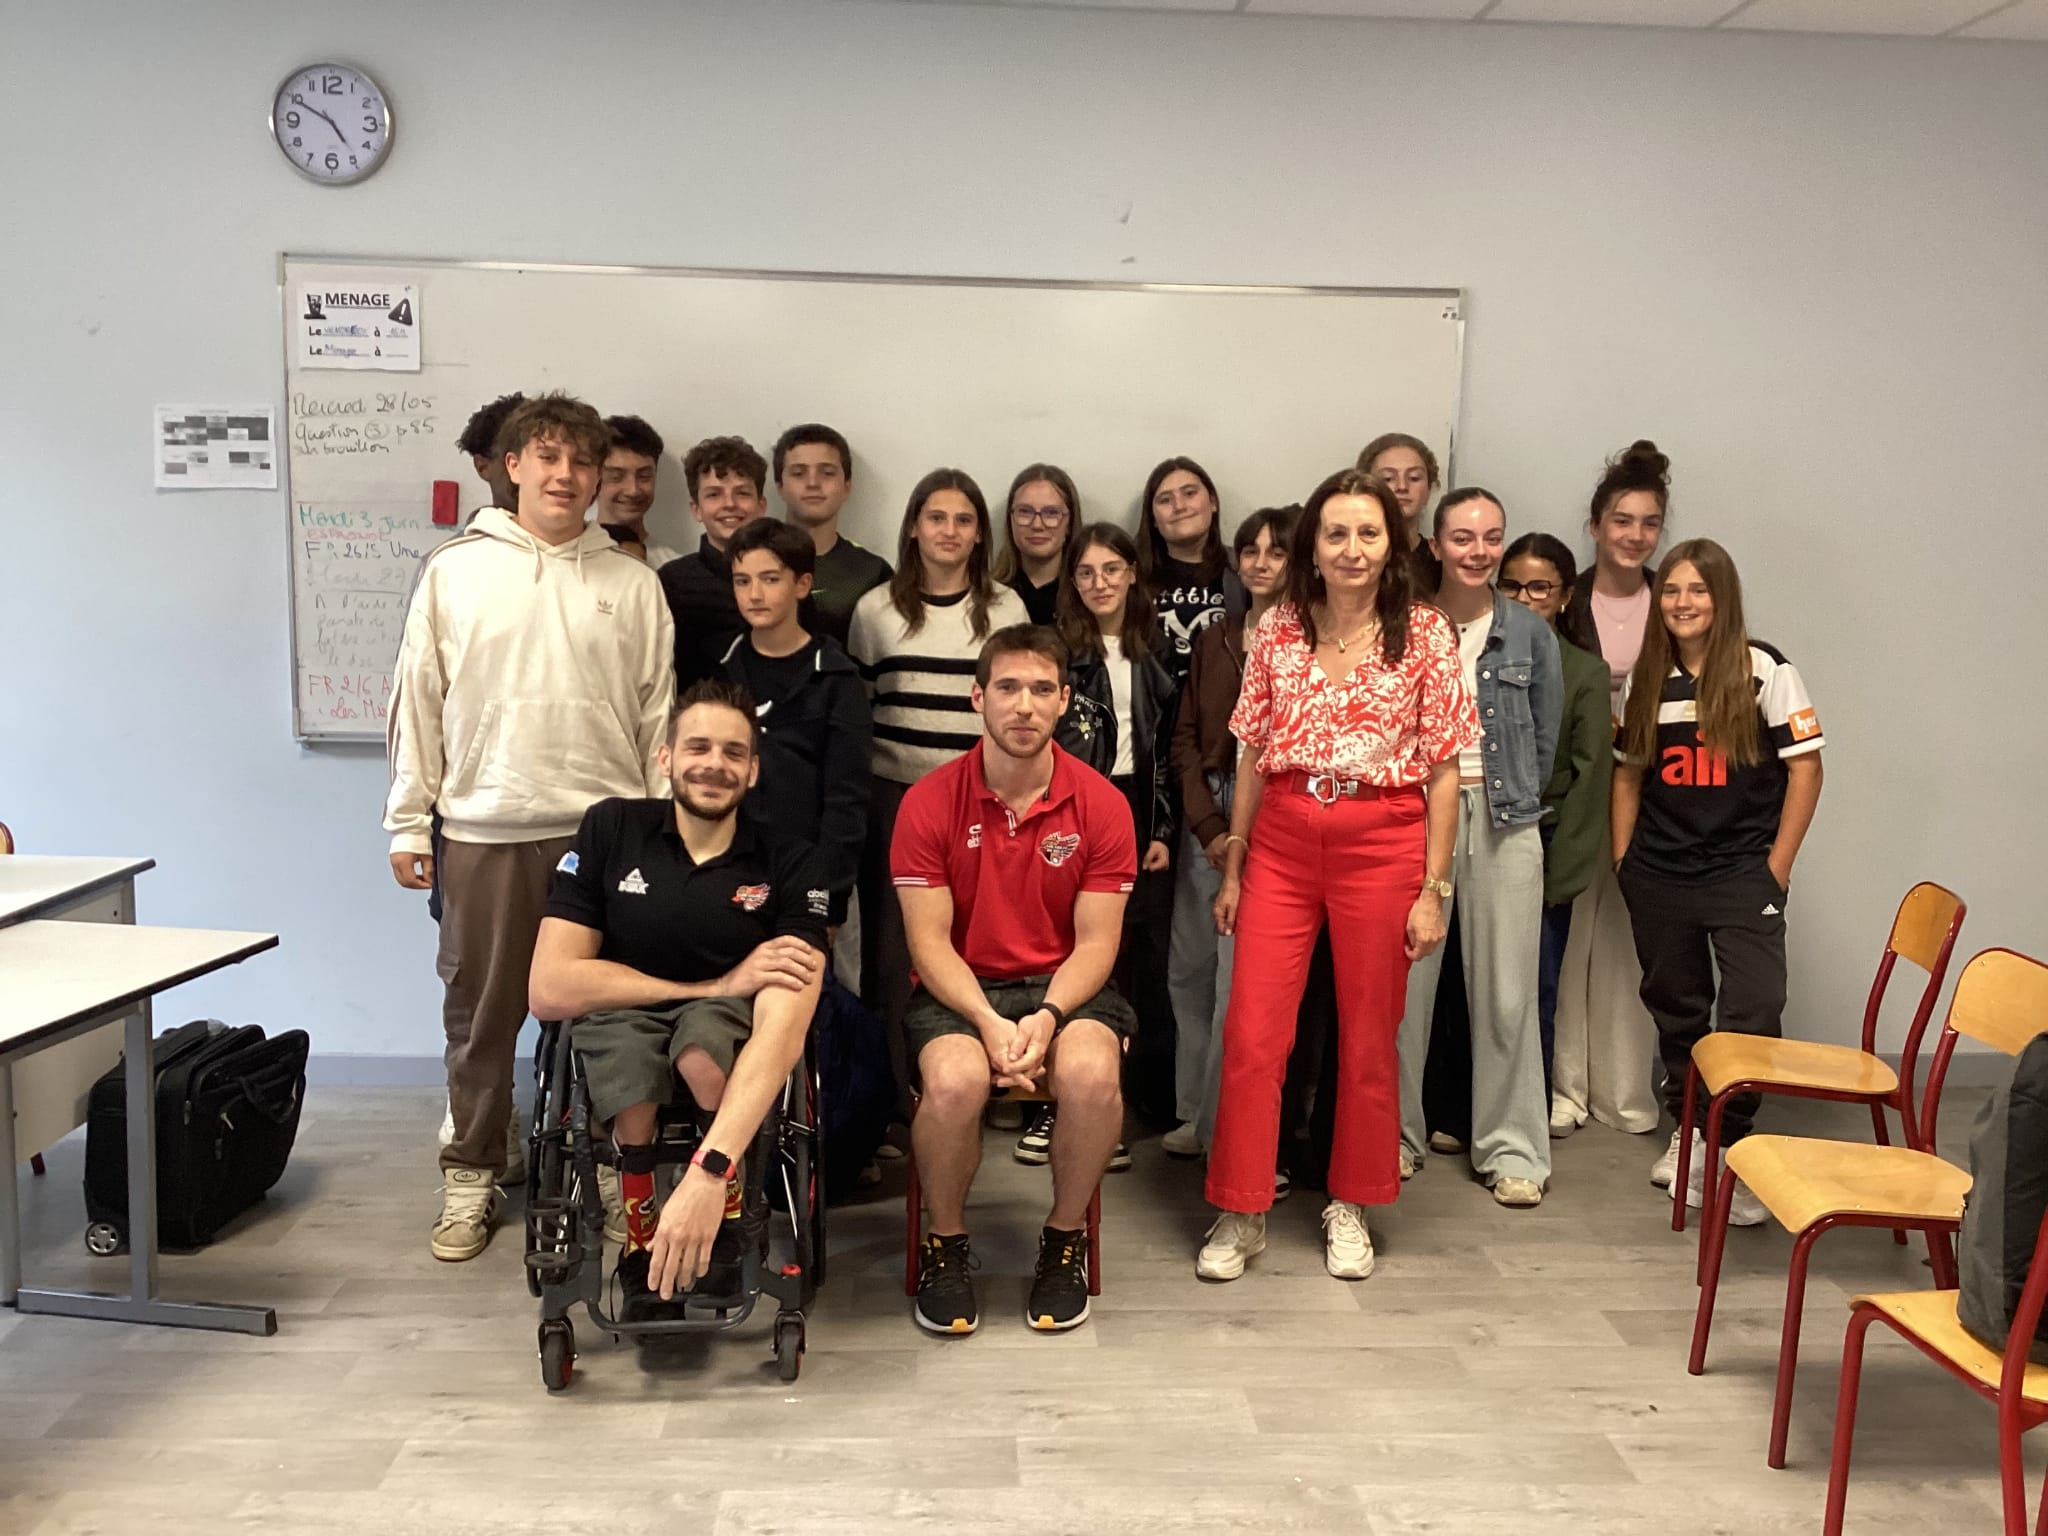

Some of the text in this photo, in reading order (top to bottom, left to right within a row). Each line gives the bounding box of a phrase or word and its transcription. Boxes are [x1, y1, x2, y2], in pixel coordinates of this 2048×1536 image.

[308, 79, 315, 92] 11
[322, 75, 343, 95] 12
[291, 93, 304, 105] 10
[362, 97, 371, 109] 2
[286, 111, 301, 129] 9
[362, 116, 378, 133] 3
[292, 137, 303, 147] 8
[362, 141, 371, 150] 4
[306, 153, 314, 167] 7
[325, 153, 339, 170] 6
[349, 155, 358, 165] 5
[325, 292, 391, 307] MENAGE
[309, 326, 322, 337] Le
[374, 326, 381, 337] à
[310, 345, 322, 356] Le
[375, 346, 381, 357] à
[1153, 586, 1224, 605] ittle
[308, 673, 335, 696] FR
